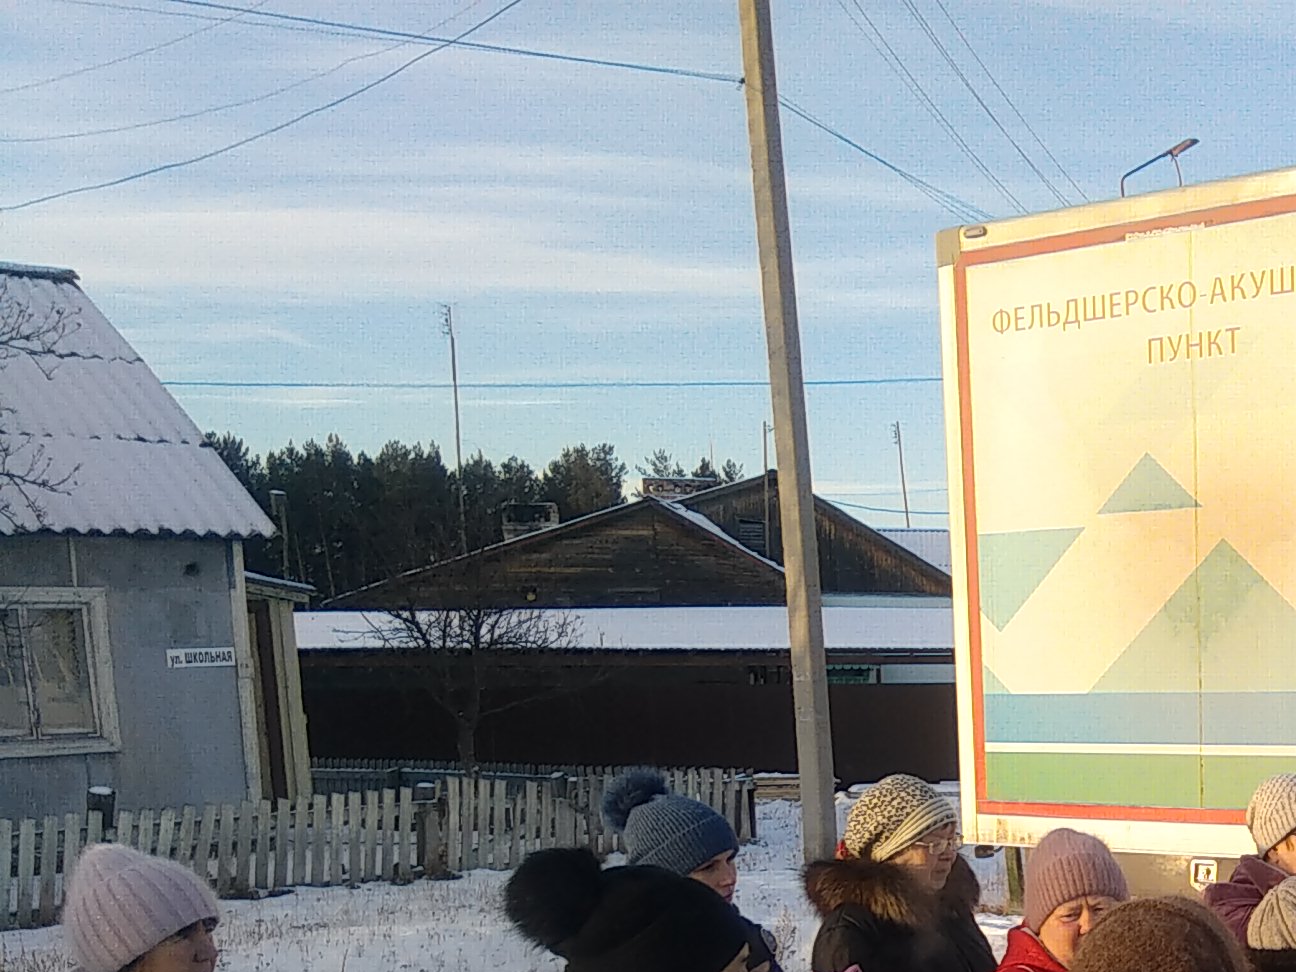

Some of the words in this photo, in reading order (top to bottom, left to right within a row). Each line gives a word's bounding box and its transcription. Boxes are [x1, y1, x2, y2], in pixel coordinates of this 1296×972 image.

[1147, 326, 1241, 365] ПУНКТ
[169, 655, 183, 668] ул.
[184, 650, 233, 664] ШКОЛЬНАЯ
